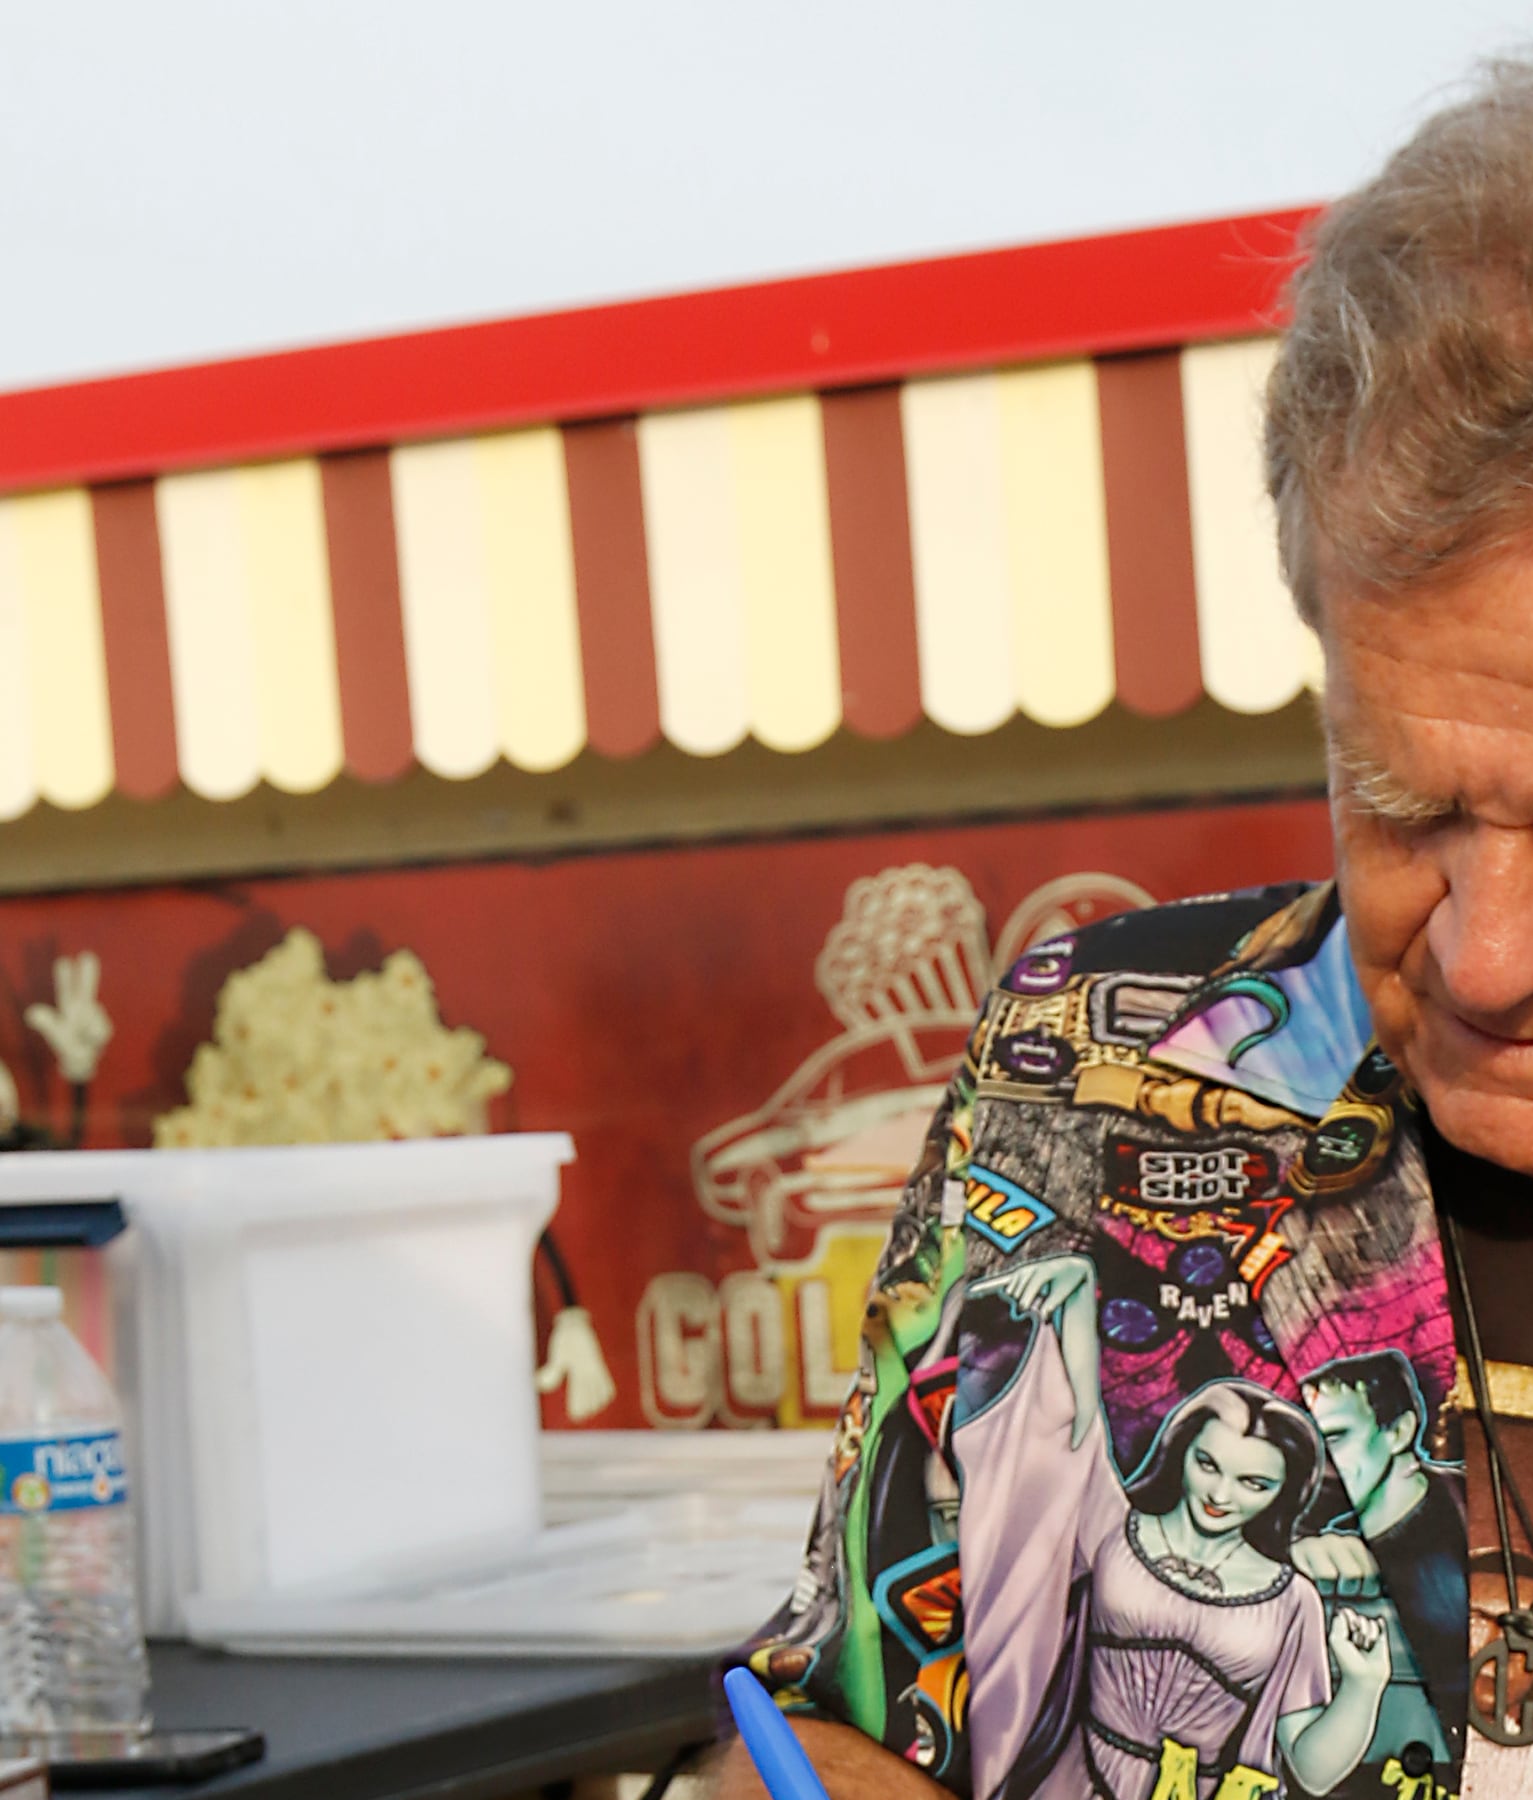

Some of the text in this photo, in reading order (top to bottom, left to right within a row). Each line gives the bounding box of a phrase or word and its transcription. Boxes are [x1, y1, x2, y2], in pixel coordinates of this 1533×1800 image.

[1138, 1147, 1250, 1177] SPOT
[1138, 1174, 1250, 1205] SHOT
[1158, 1282, 1250, 1328] RAVEN
